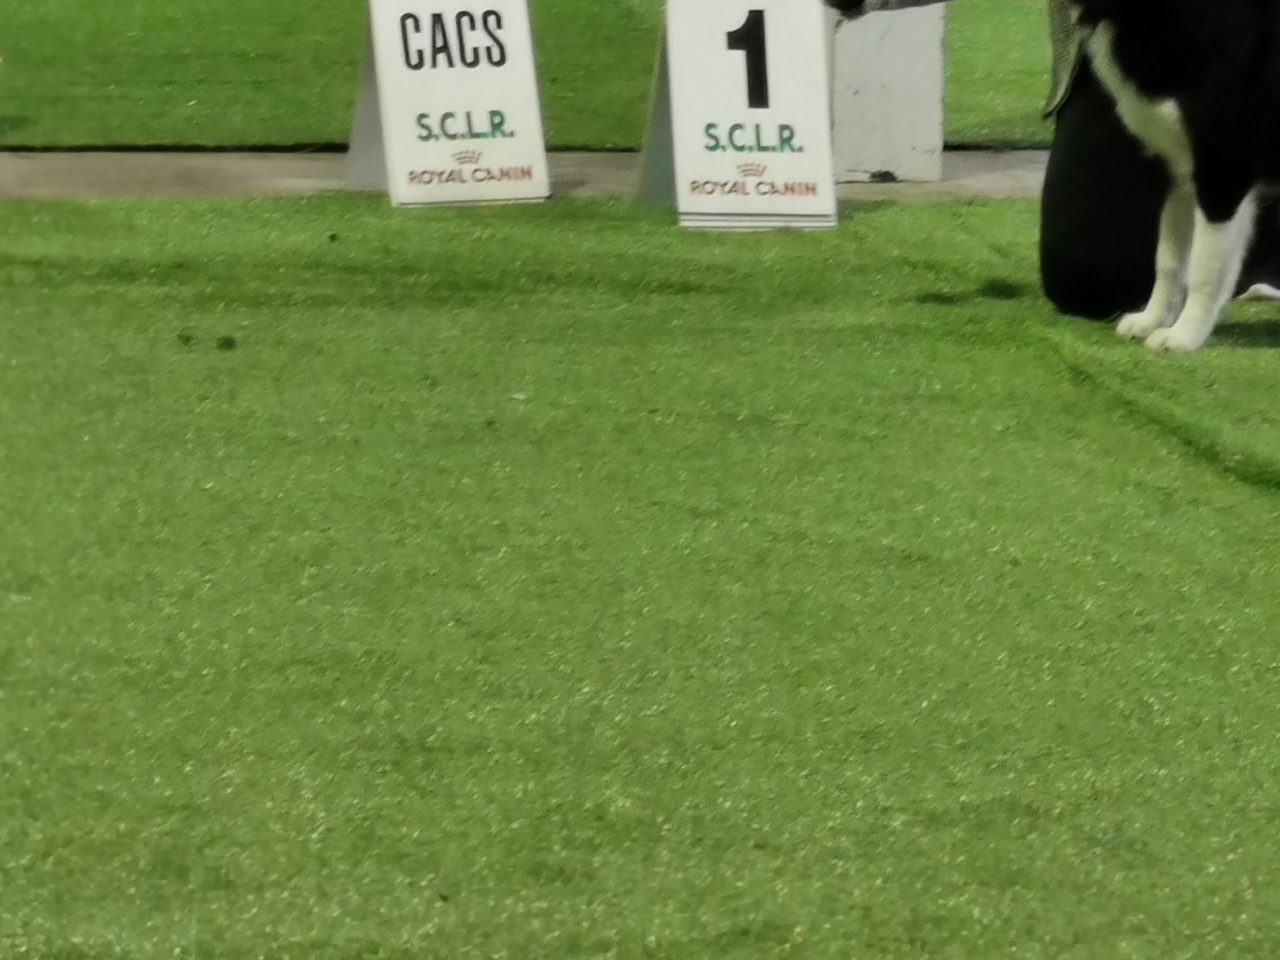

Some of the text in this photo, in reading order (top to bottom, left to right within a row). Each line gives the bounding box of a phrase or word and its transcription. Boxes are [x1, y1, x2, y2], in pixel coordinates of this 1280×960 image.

[400, 9, 507, 70] CACS
[727, 9, 770, 109] 1
[416, 110, 515, 141] S.C.L.R.
[704, 122, 805, 152] S.C.L.R.
[408, 165, 533, 186] ROYAL CANIN
[690, 180, 817, 197] ROYAL CANIN
